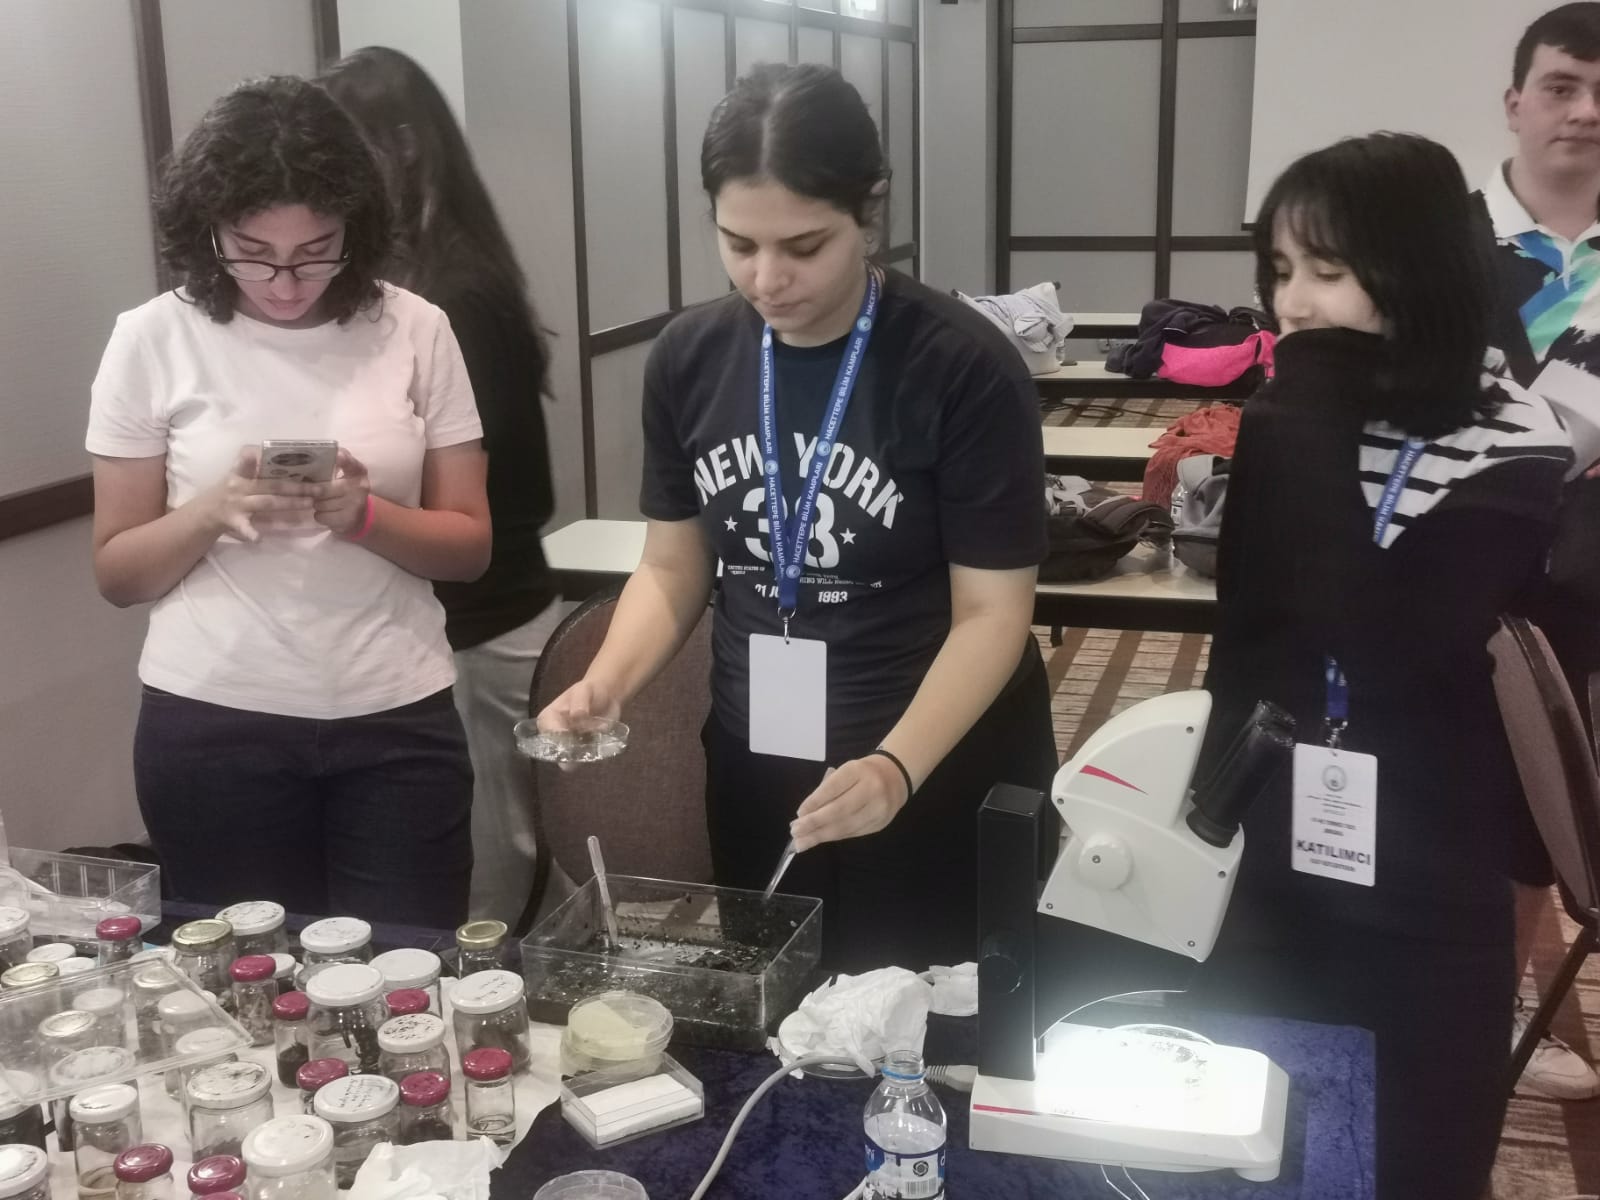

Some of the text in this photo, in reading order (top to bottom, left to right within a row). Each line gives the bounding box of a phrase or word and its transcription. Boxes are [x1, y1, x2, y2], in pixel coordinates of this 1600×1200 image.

[825, 395, 844, 441] HACETTEPE
[845, 337, 864, 376] KAMPLARI
[693, 432, 904, 530] NEW YORK
[768, 477, 779, 520] HACETTEPE
[792, 521, 807, 563] HACETTEPE
[806, 462, 823, 501] KAMPLARI
[1296, 840, 1371, 866] KATILIMCI
